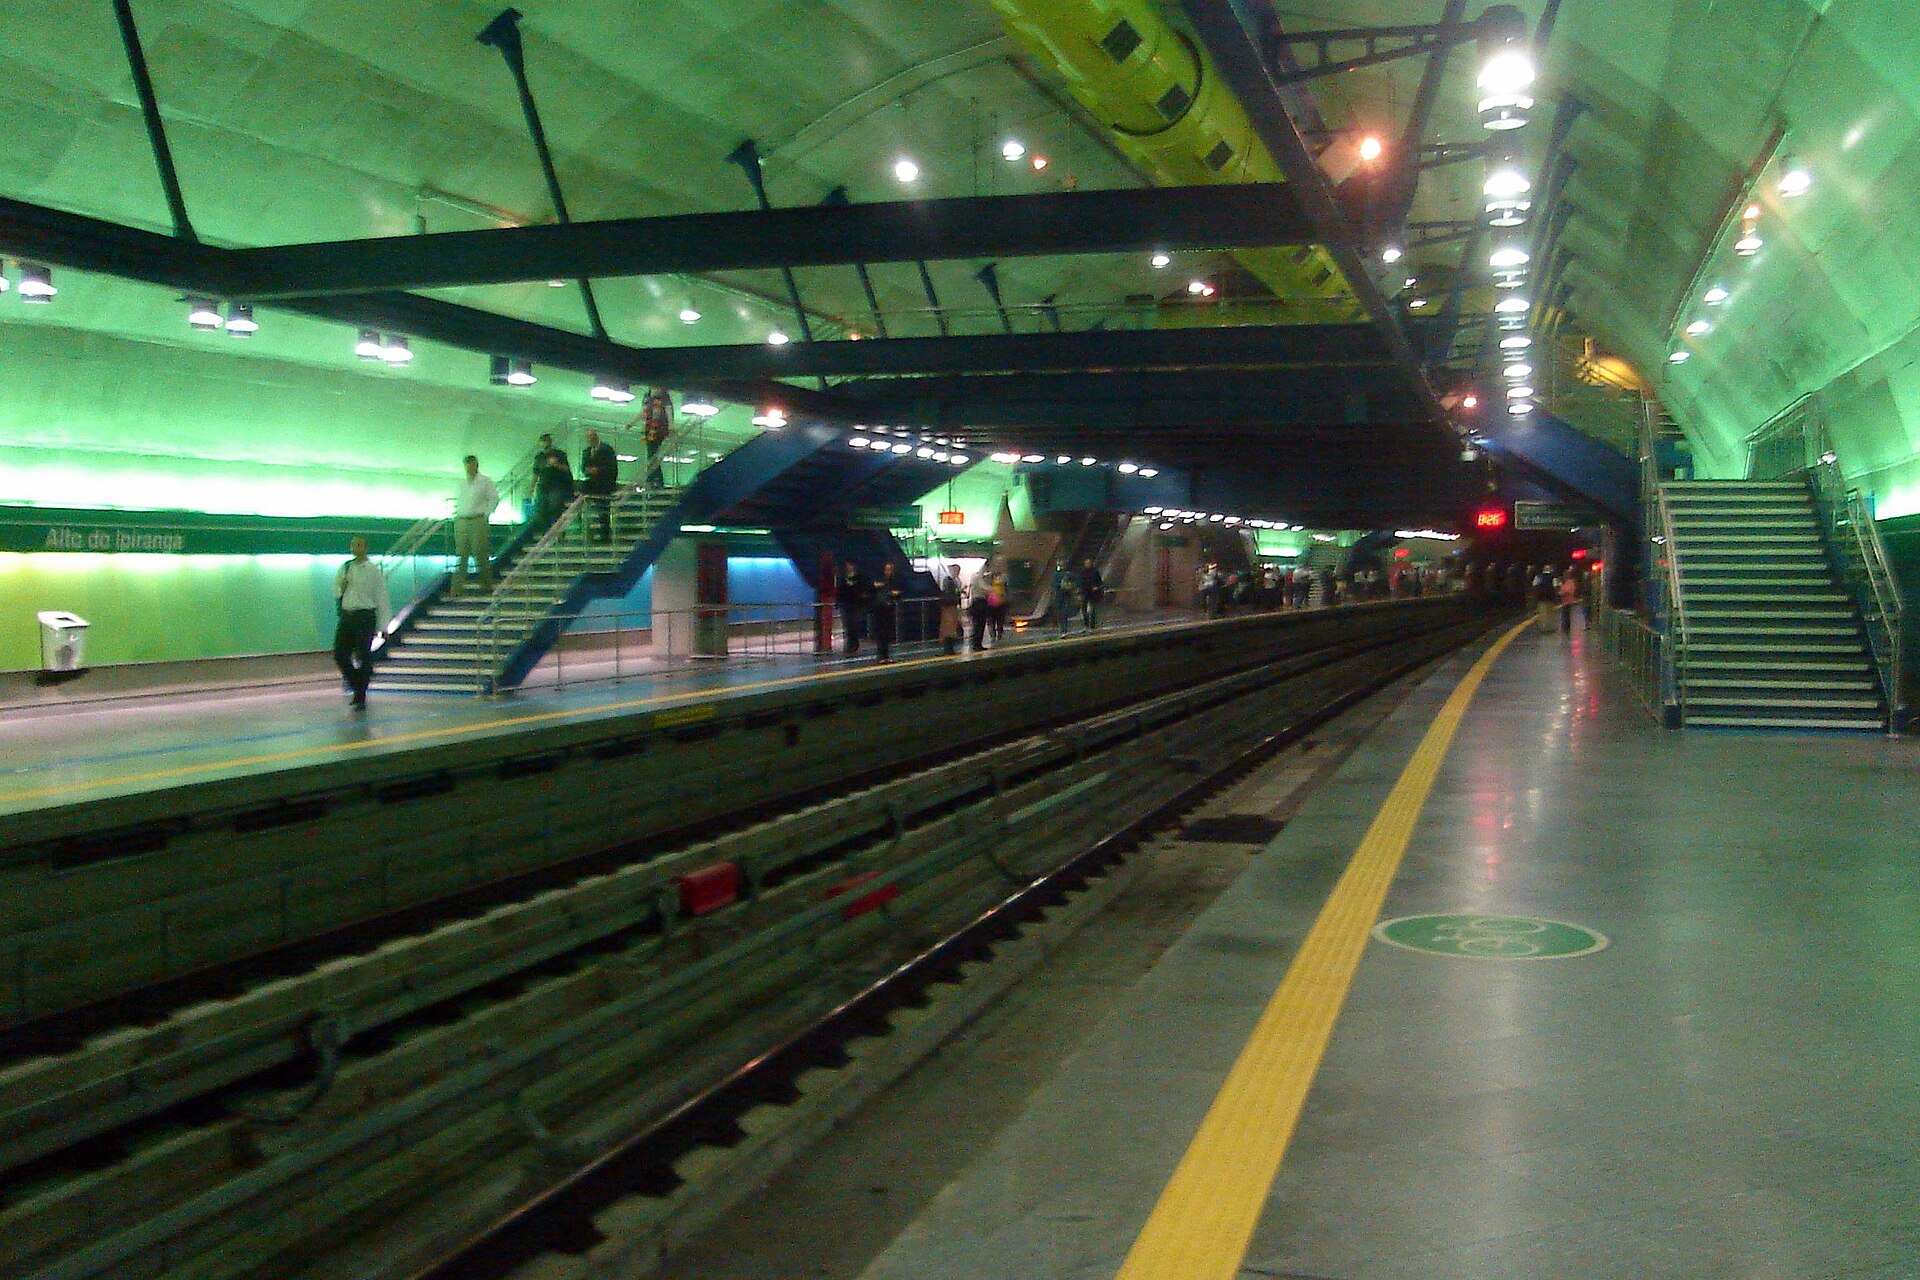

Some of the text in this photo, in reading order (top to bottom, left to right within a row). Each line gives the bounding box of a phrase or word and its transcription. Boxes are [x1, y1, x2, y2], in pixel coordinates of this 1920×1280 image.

[45, 528, 184, 551] Alto do Ipiranga
